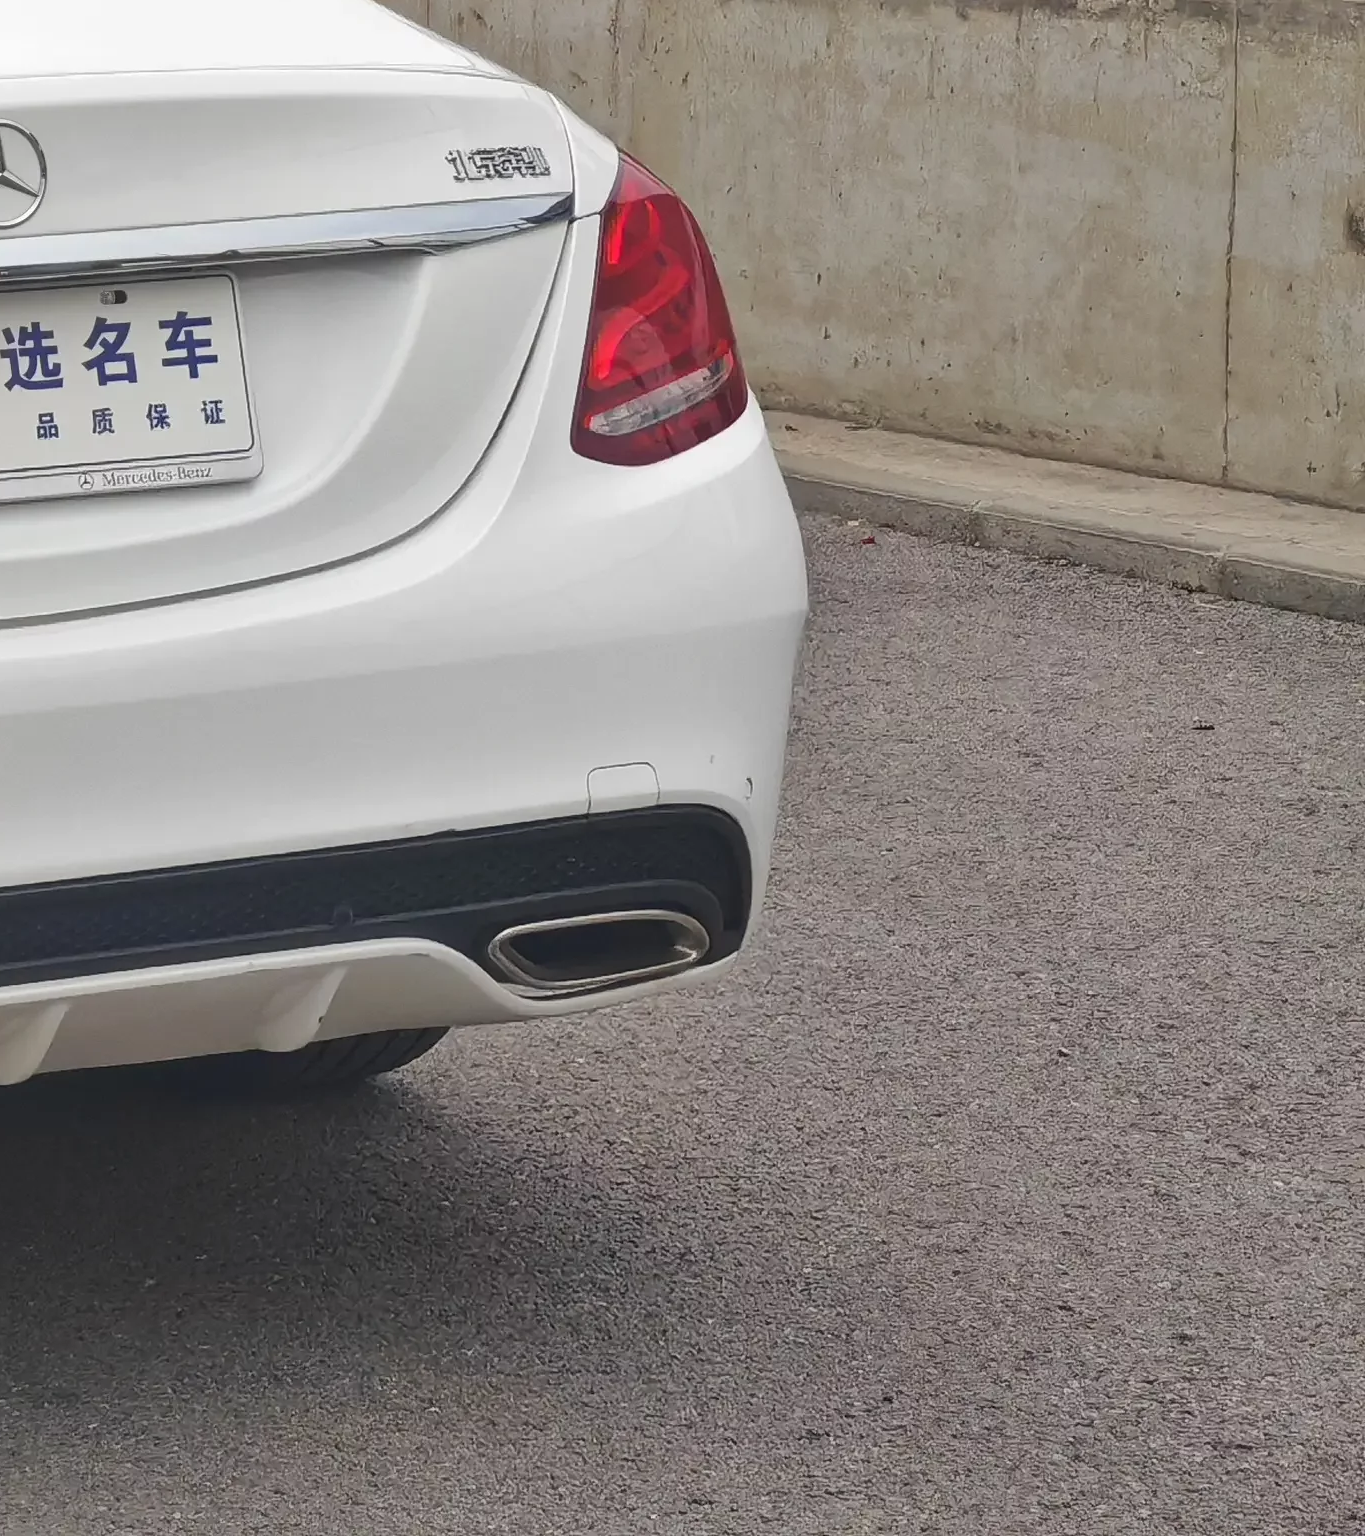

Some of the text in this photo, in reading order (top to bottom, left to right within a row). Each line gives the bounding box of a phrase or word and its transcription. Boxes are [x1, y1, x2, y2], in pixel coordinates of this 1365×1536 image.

[35, 398, 226, 441] 品质保证
[101, 466, 213, 487] Mercedes-Benz
